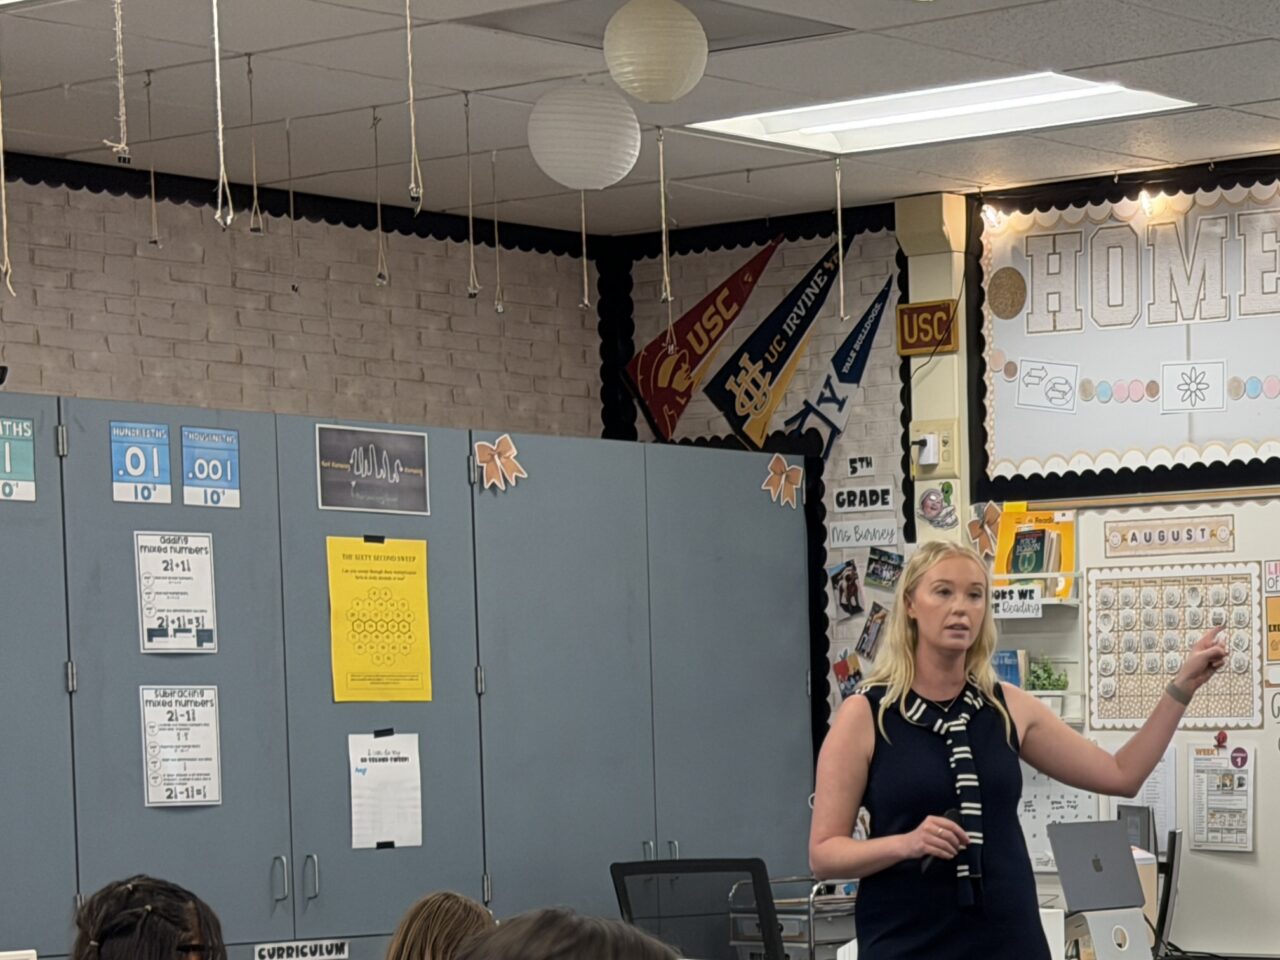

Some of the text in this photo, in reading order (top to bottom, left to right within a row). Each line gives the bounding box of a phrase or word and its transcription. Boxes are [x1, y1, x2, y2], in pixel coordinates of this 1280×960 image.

[686, 287, 739, 356] USC
[763, 268, 829, 365] UC IRVINE
[903, 311, 947, 344] USC
[849, 456, 873, 475] 5TH
[835, 488, 890, 508] GRADE
[1130, 527, 1208, 545] AUGUST
[1268, 576, 1280, 590] OF
[1018, 589, 1035, 600] WE
[1002, 602, 1041, 617] Reading
[258, 942, 346, 960] CURRICULUM
